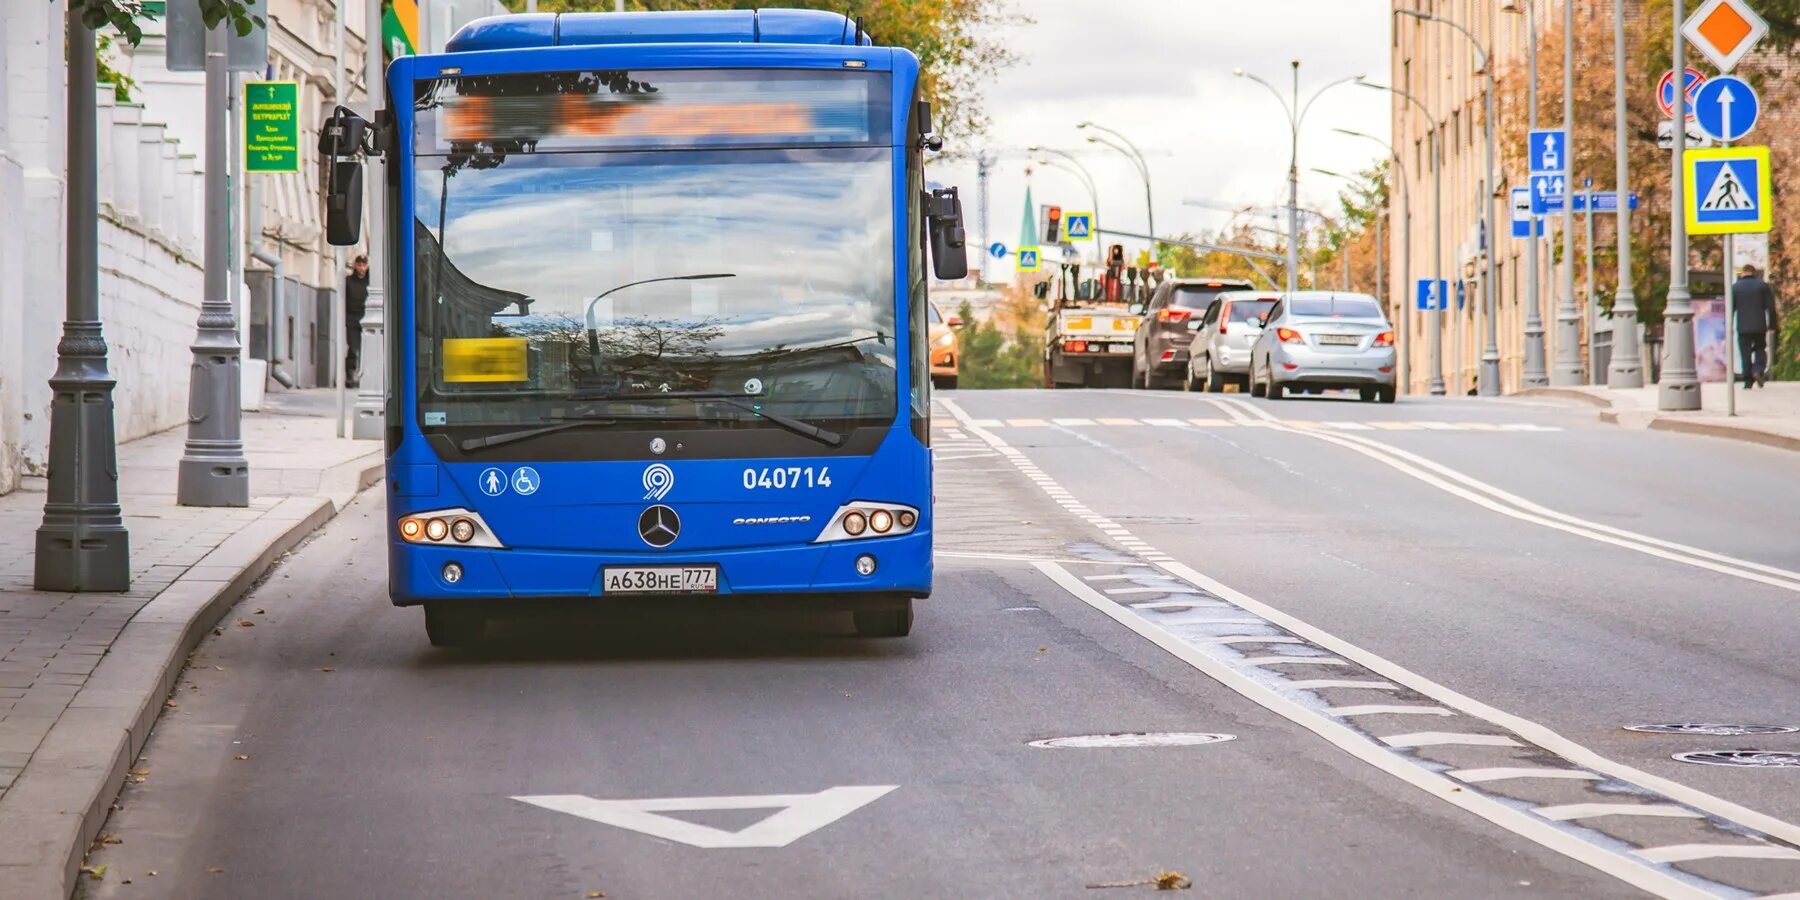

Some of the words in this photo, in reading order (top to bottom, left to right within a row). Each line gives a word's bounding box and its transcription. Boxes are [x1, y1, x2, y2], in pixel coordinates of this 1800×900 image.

[743, 467, 832, 489] 040714
[733, 516, 811, 526] CONECTO
[684, 570, 711, 584] 777
